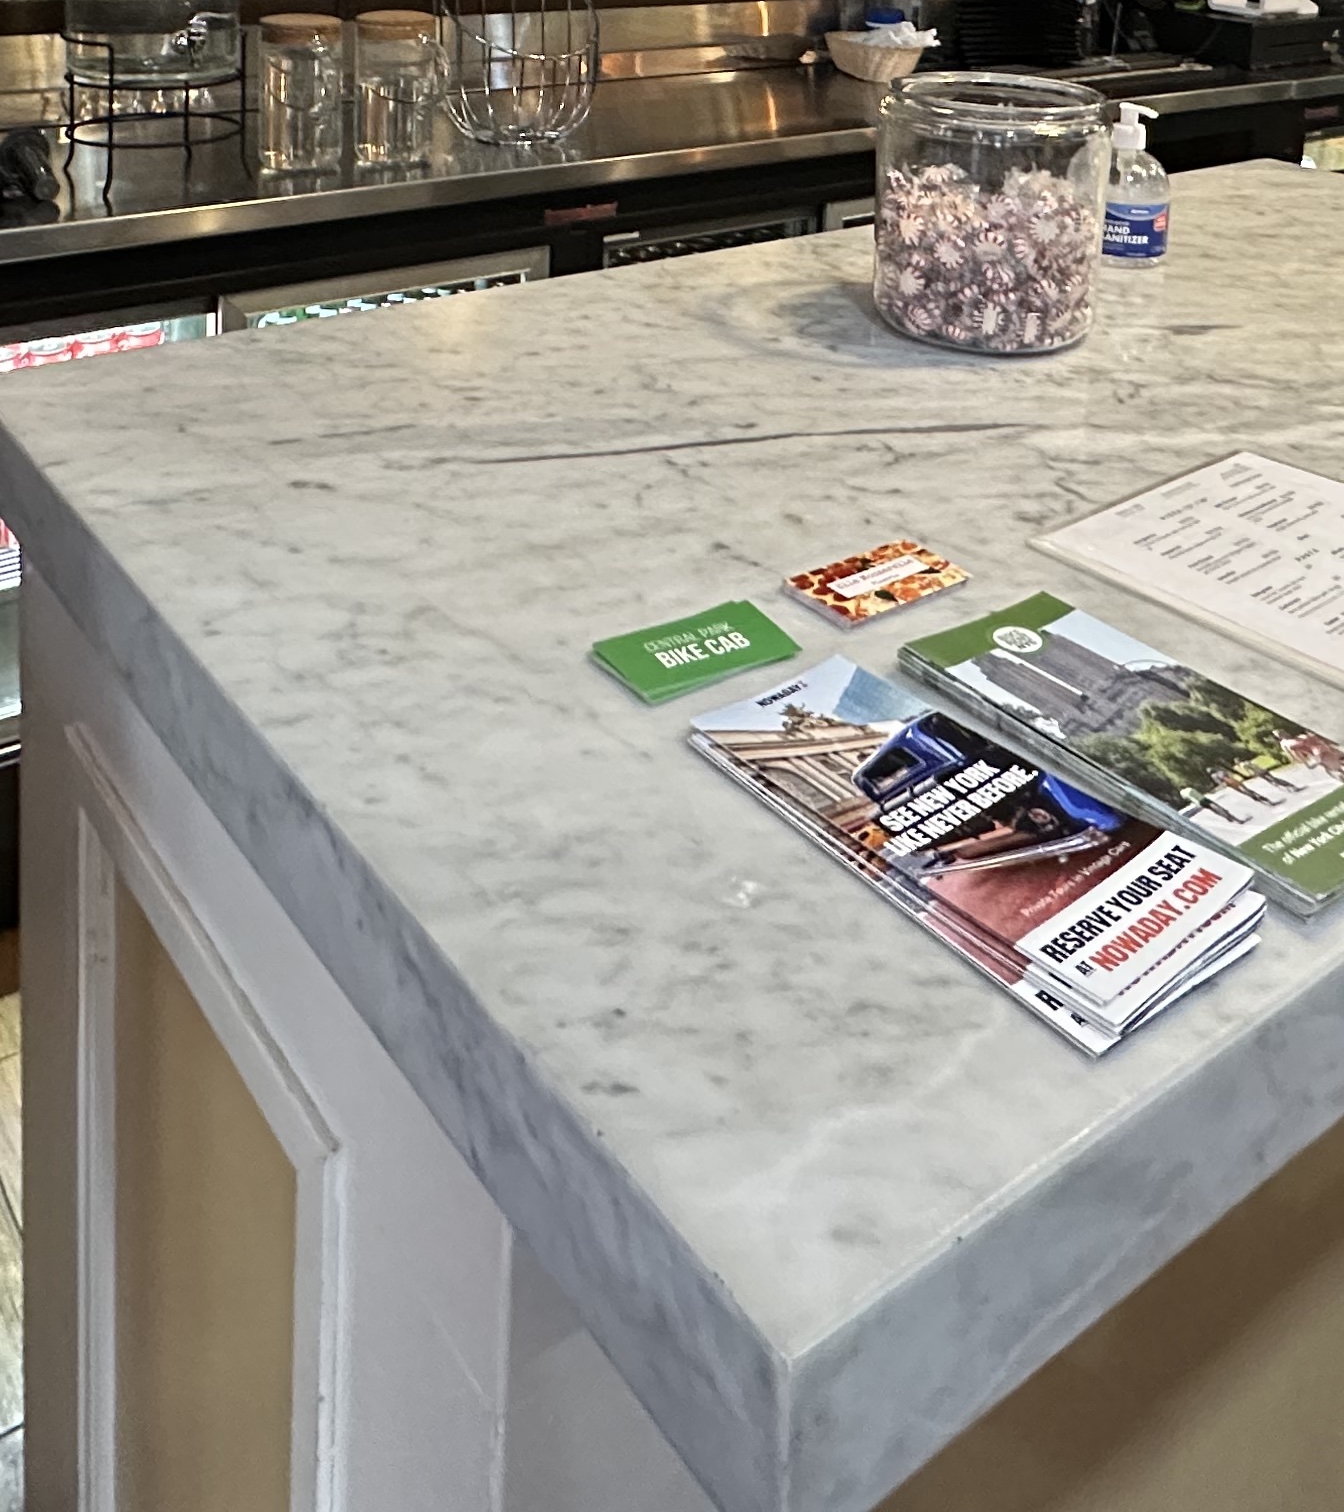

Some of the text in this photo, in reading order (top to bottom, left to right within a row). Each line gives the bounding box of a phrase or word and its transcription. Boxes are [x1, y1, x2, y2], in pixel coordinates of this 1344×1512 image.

[1103, 233, 1149, 245] ANITIZER
[643, 620, 736, 654] CENTRAL PARK
[654, 631, 751, 669] BIKE CAB
[879, 758, 1001, 833] SEE NEW YORK
[883, 764, 1039, 857] LIKE NEVER BEFORE.
[1308, 831, 1335, 848] York
[1039, 901, 1122, 964] RESERVE
[1104, 874, 1163, 919] YOUR
[1147, 844, 1197, 882] SEAT
[1075, 960, 1095, 976] AT
[1088, 867, 1224, 972] NOWADAY.COM
